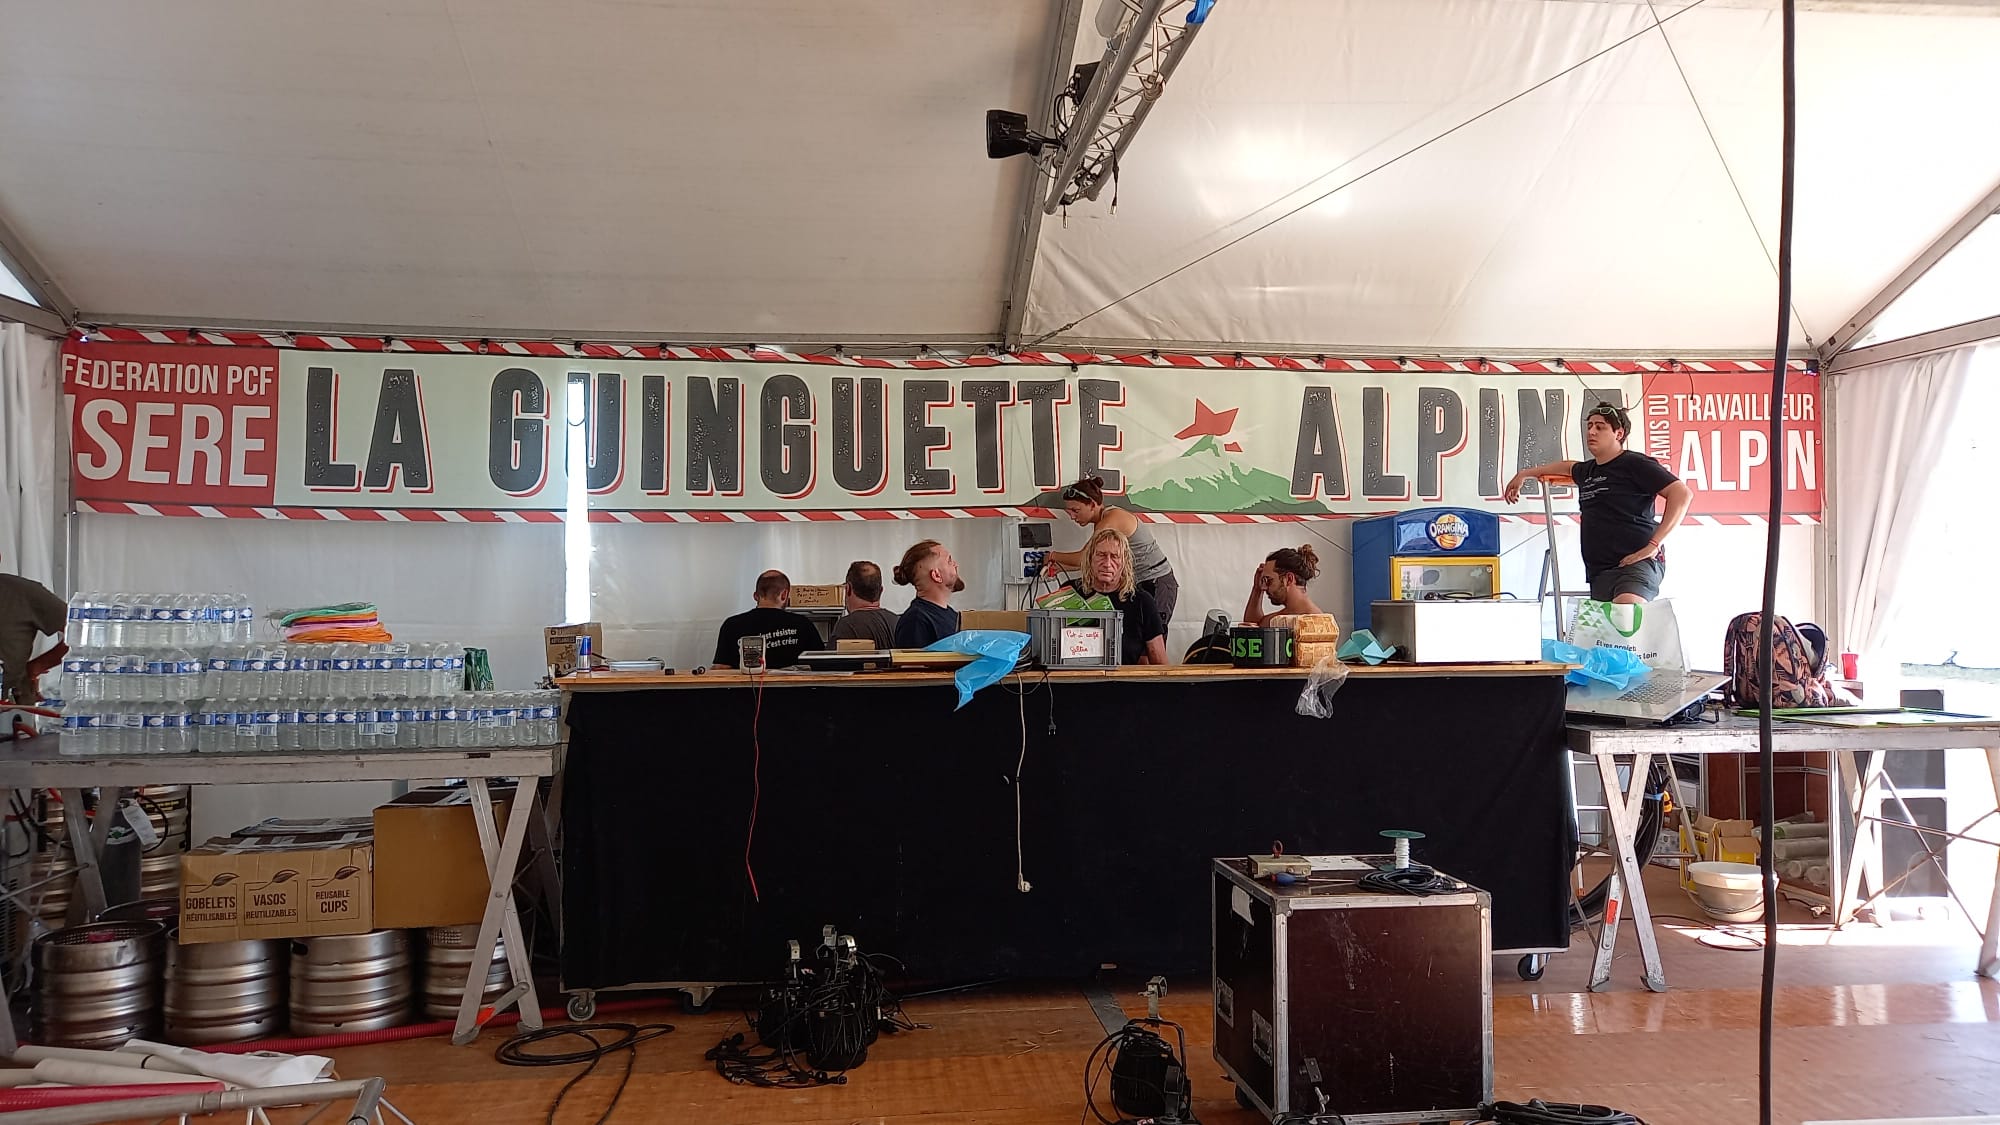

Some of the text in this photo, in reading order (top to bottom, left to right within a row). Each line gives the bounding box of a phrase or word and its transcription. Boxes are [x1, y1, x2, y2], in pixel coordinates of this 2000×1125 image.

[61, 353, 274, 396] FEDERATION PCF
[1648, 394, 1669, 416] DU
[304, 367, 434, 493] LA
[488, 367, 1126, 498] GUINGUETTE
[1649, 420, 1671, 460] AMIS
[1678, 430, 1817, 491] ALPN
[185, 896, 236, 909] GOBELETS
[253, 893, 287, 906] VASOS
[315, 889, 350, 900] REUSABLE
[245, 909, 297, 919] REUTILIZABLES
[320, 900, 348, 913] CUPS
